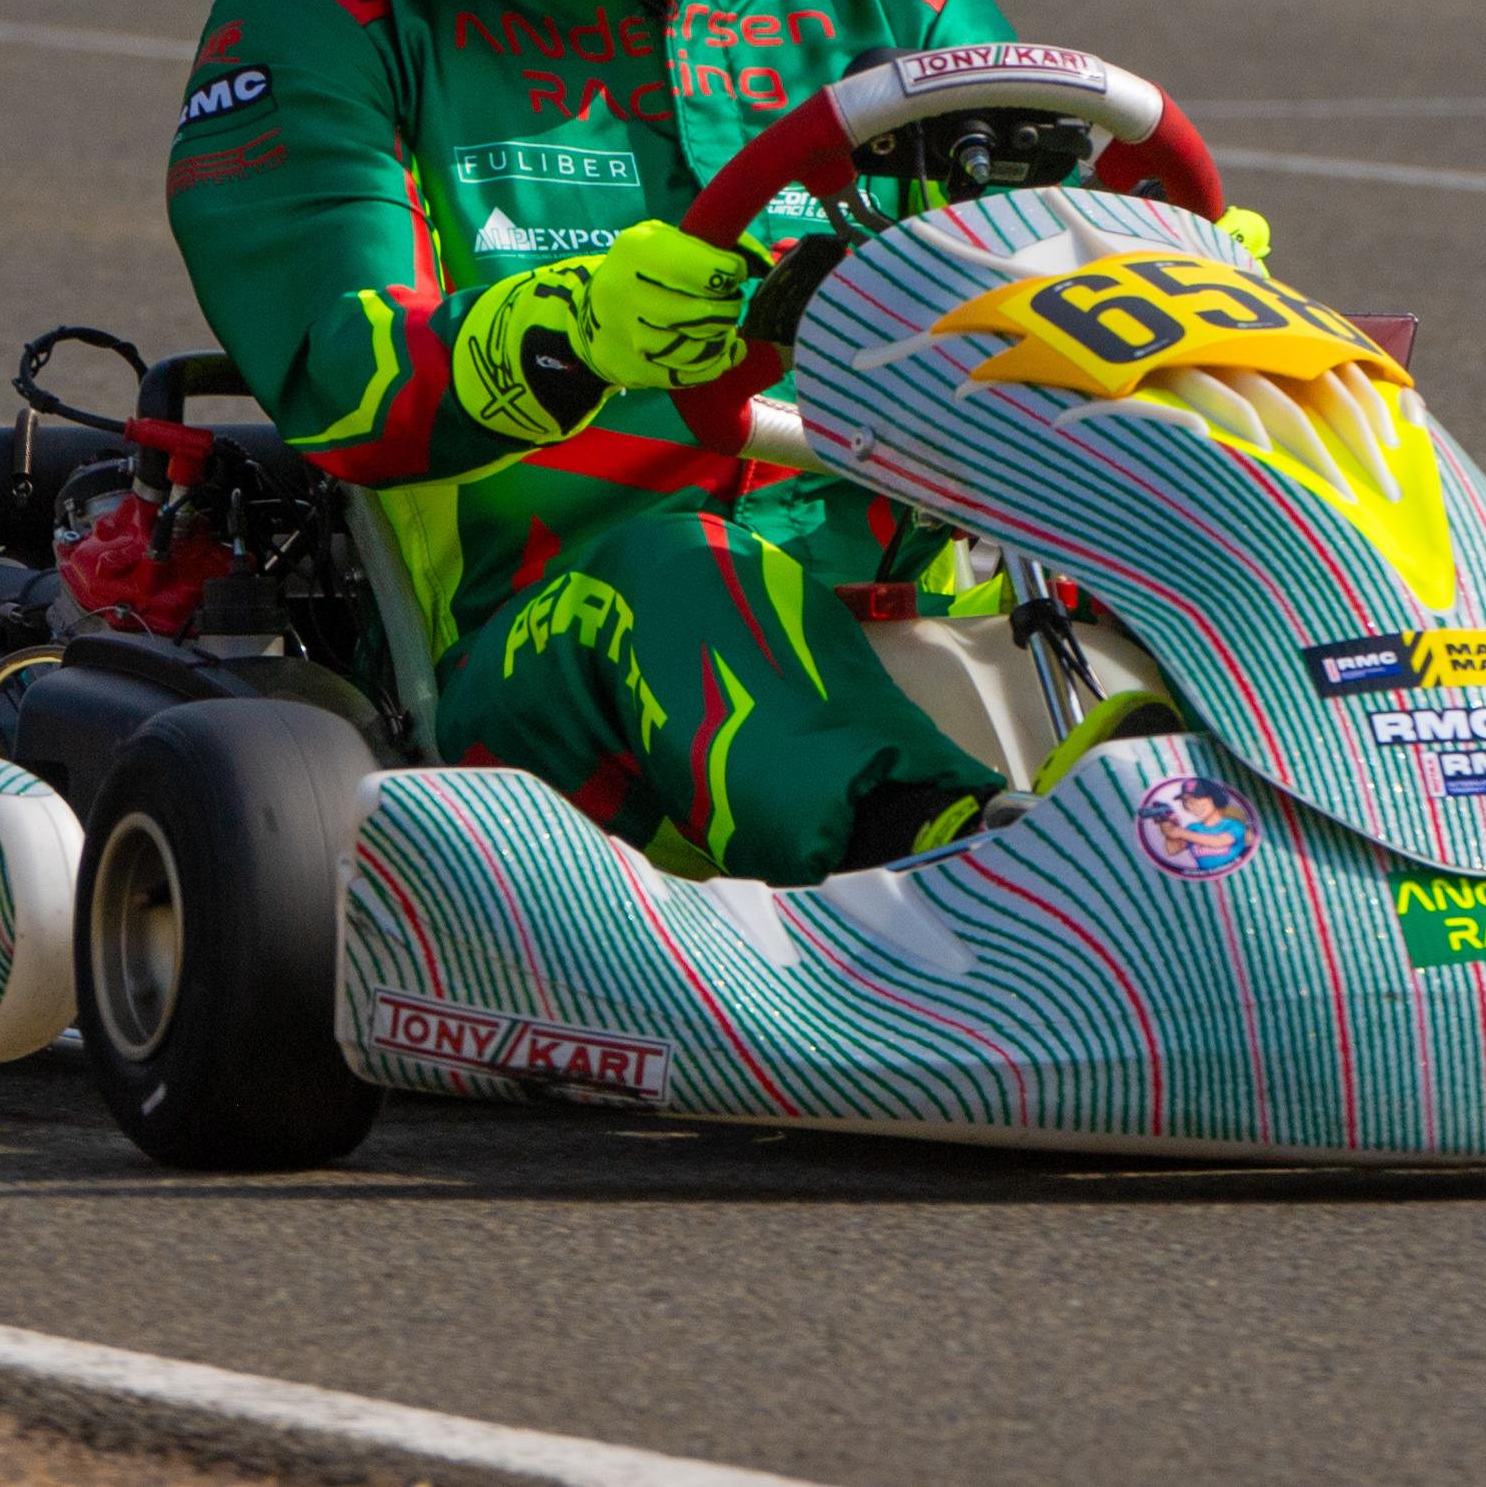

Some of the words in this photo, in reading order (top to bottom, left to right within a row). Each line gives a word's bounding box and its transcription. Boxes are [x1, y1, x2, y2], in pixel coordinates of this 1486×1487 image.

[912, 47, 993, 75] TONY
[1015, 46, 1093, 70] KART
[463, 150, 628, 179] FULIBER
[474, 226, 622, 253] ALPEXPO
[1029, 259, 1386, 365] 658
[1337, 650, 1398, 671] RMC
[380, 996, 500, 1060] TONY
[527, 1028, 664, 1086] KART
